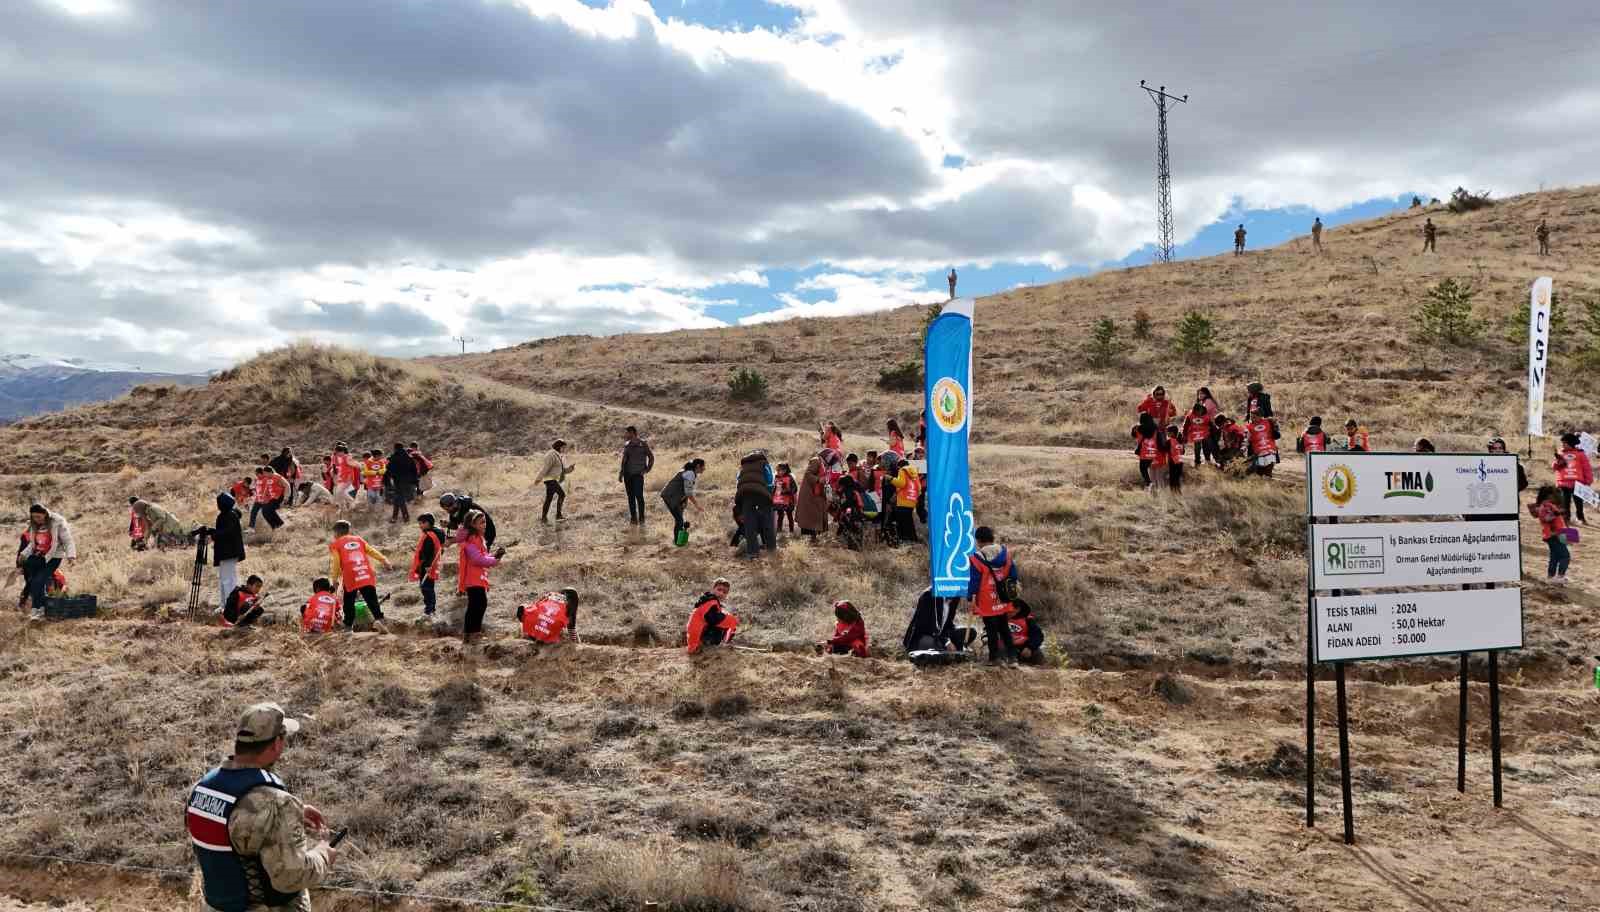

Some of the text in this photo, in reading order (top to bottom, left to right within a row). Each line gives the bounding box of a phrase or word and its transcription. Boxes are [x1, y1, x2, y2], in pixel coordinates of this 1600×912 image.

[1384, 472, 1423, 490] TEMA
[1389, 532, 1517, 547] İş Bankası Erzincan Ağaçlandırması
[1347, 543, 1367, 555] ilde
[1347, 559, 1381, 569] orman
[1395, 551, 1511, 564] Orman Genel Müdürlüğü Tarafından
[1326, 605, 1349, 617] TESİS
[1350, 604, 1377, 616] TARİHİ
[1396, 603, 1417, 614] 2024
[1326, 623, 1353, 633] ALANI
[1396, 618, 1415, 630] 50,0
[1417, 617, 1446, 628] Hektar
[1327, 636, 1353, 648] FİDAN
[1355, 634, 1381, 646] ADEDİ
[1397, 633, 1426, 644] 50.000
[190, 792, 227, 817] JANDARMA
